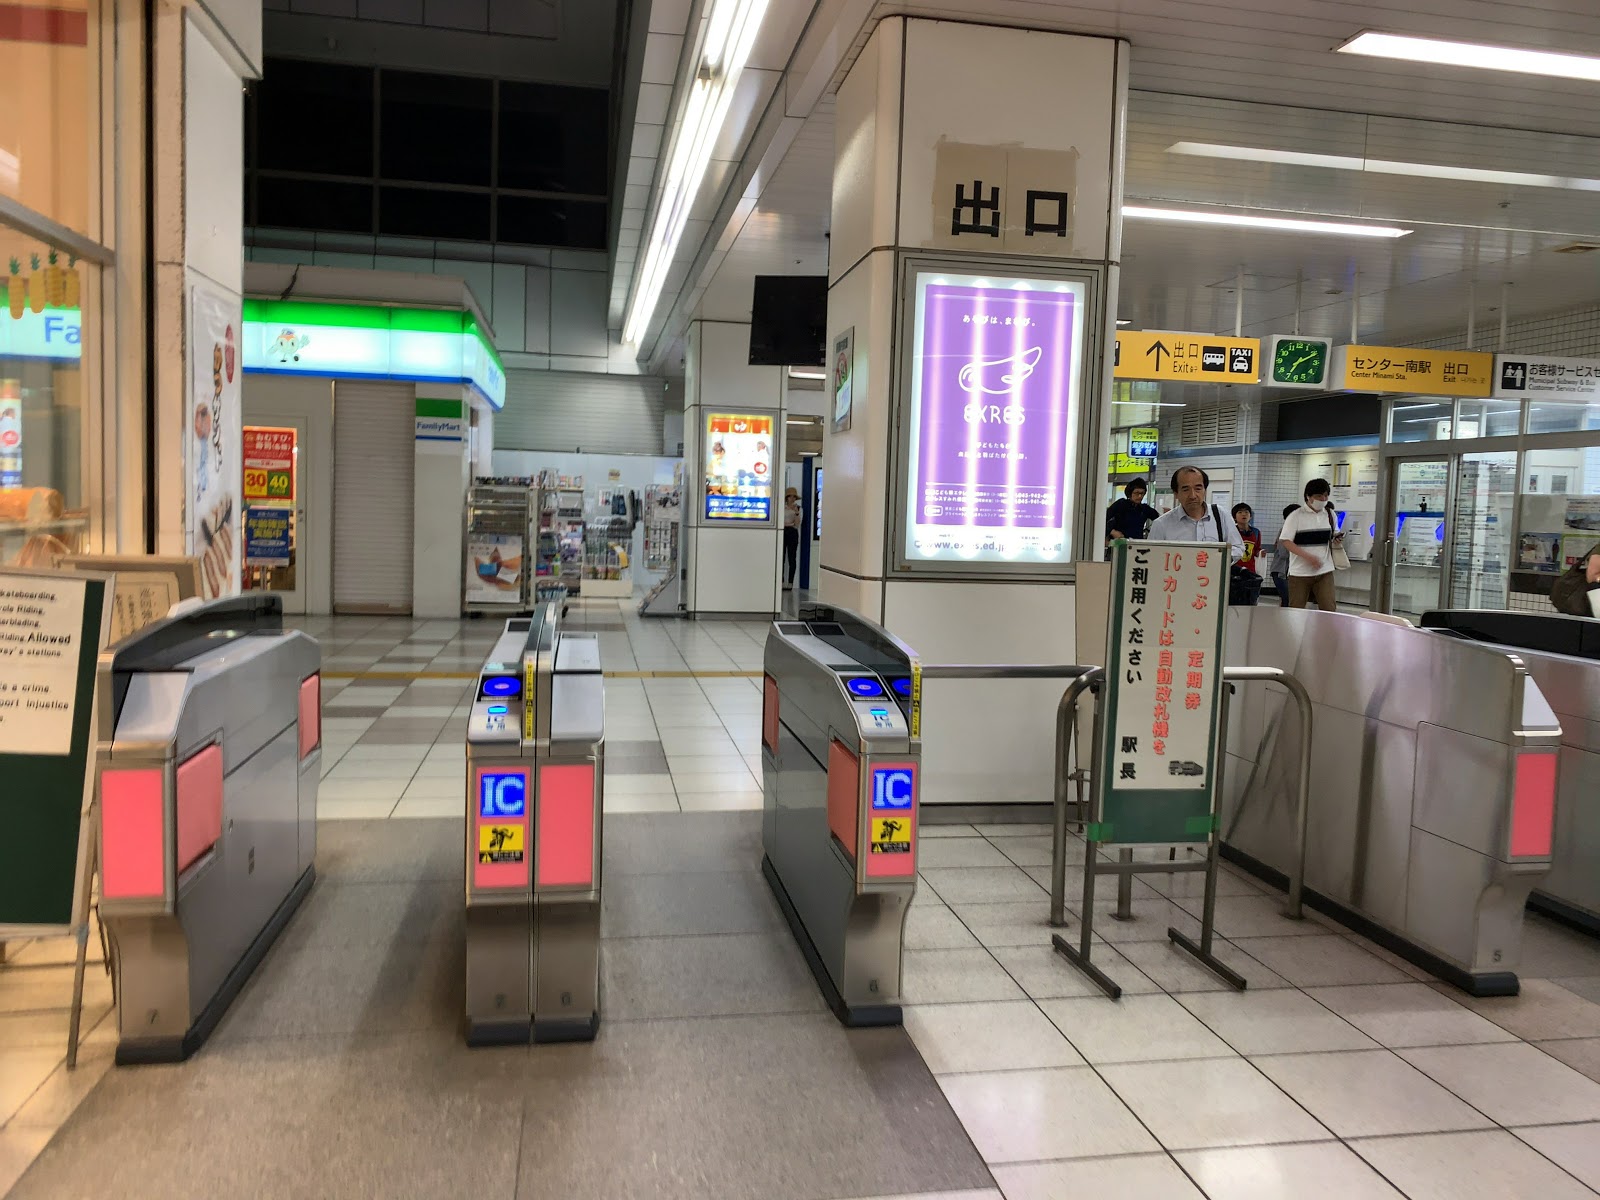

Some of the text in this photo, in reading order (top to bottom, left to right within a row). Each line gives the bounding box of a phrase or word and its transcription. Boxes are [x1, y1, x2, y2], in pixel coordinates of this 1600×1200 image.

[951, 180, 1068, 237] 出口
[44, 316, 81, 345] Fa
[1174, 341, 1198, 358] 出口
[1231, 348, 1252, 356] TAXI
[1173, 361, 1189, 373] Exit
[1353, 357, 1469, 375] センター南駅 出口
[1557, 378, 1578, 386] Subway
[416, 421, 460, 431] FamilyMart
[734, 422, 747, 431] ゆ
[246, 473, 288, 489] 30 40
[28, 632, 71, 644] Allowed
[1185, 551, 1209, 709] きっぷ・定期券
[1152, 552, 1182, 755] ICカードは自動改札機を
[1120, 548, 1150, 779] ご利用ください 駅長
[26, 699, 69, 710] injustice
[482, 775, 524, 815] IC
[875, 772, 911, 807] IC
[1493, 949, 1502, 962] 5
